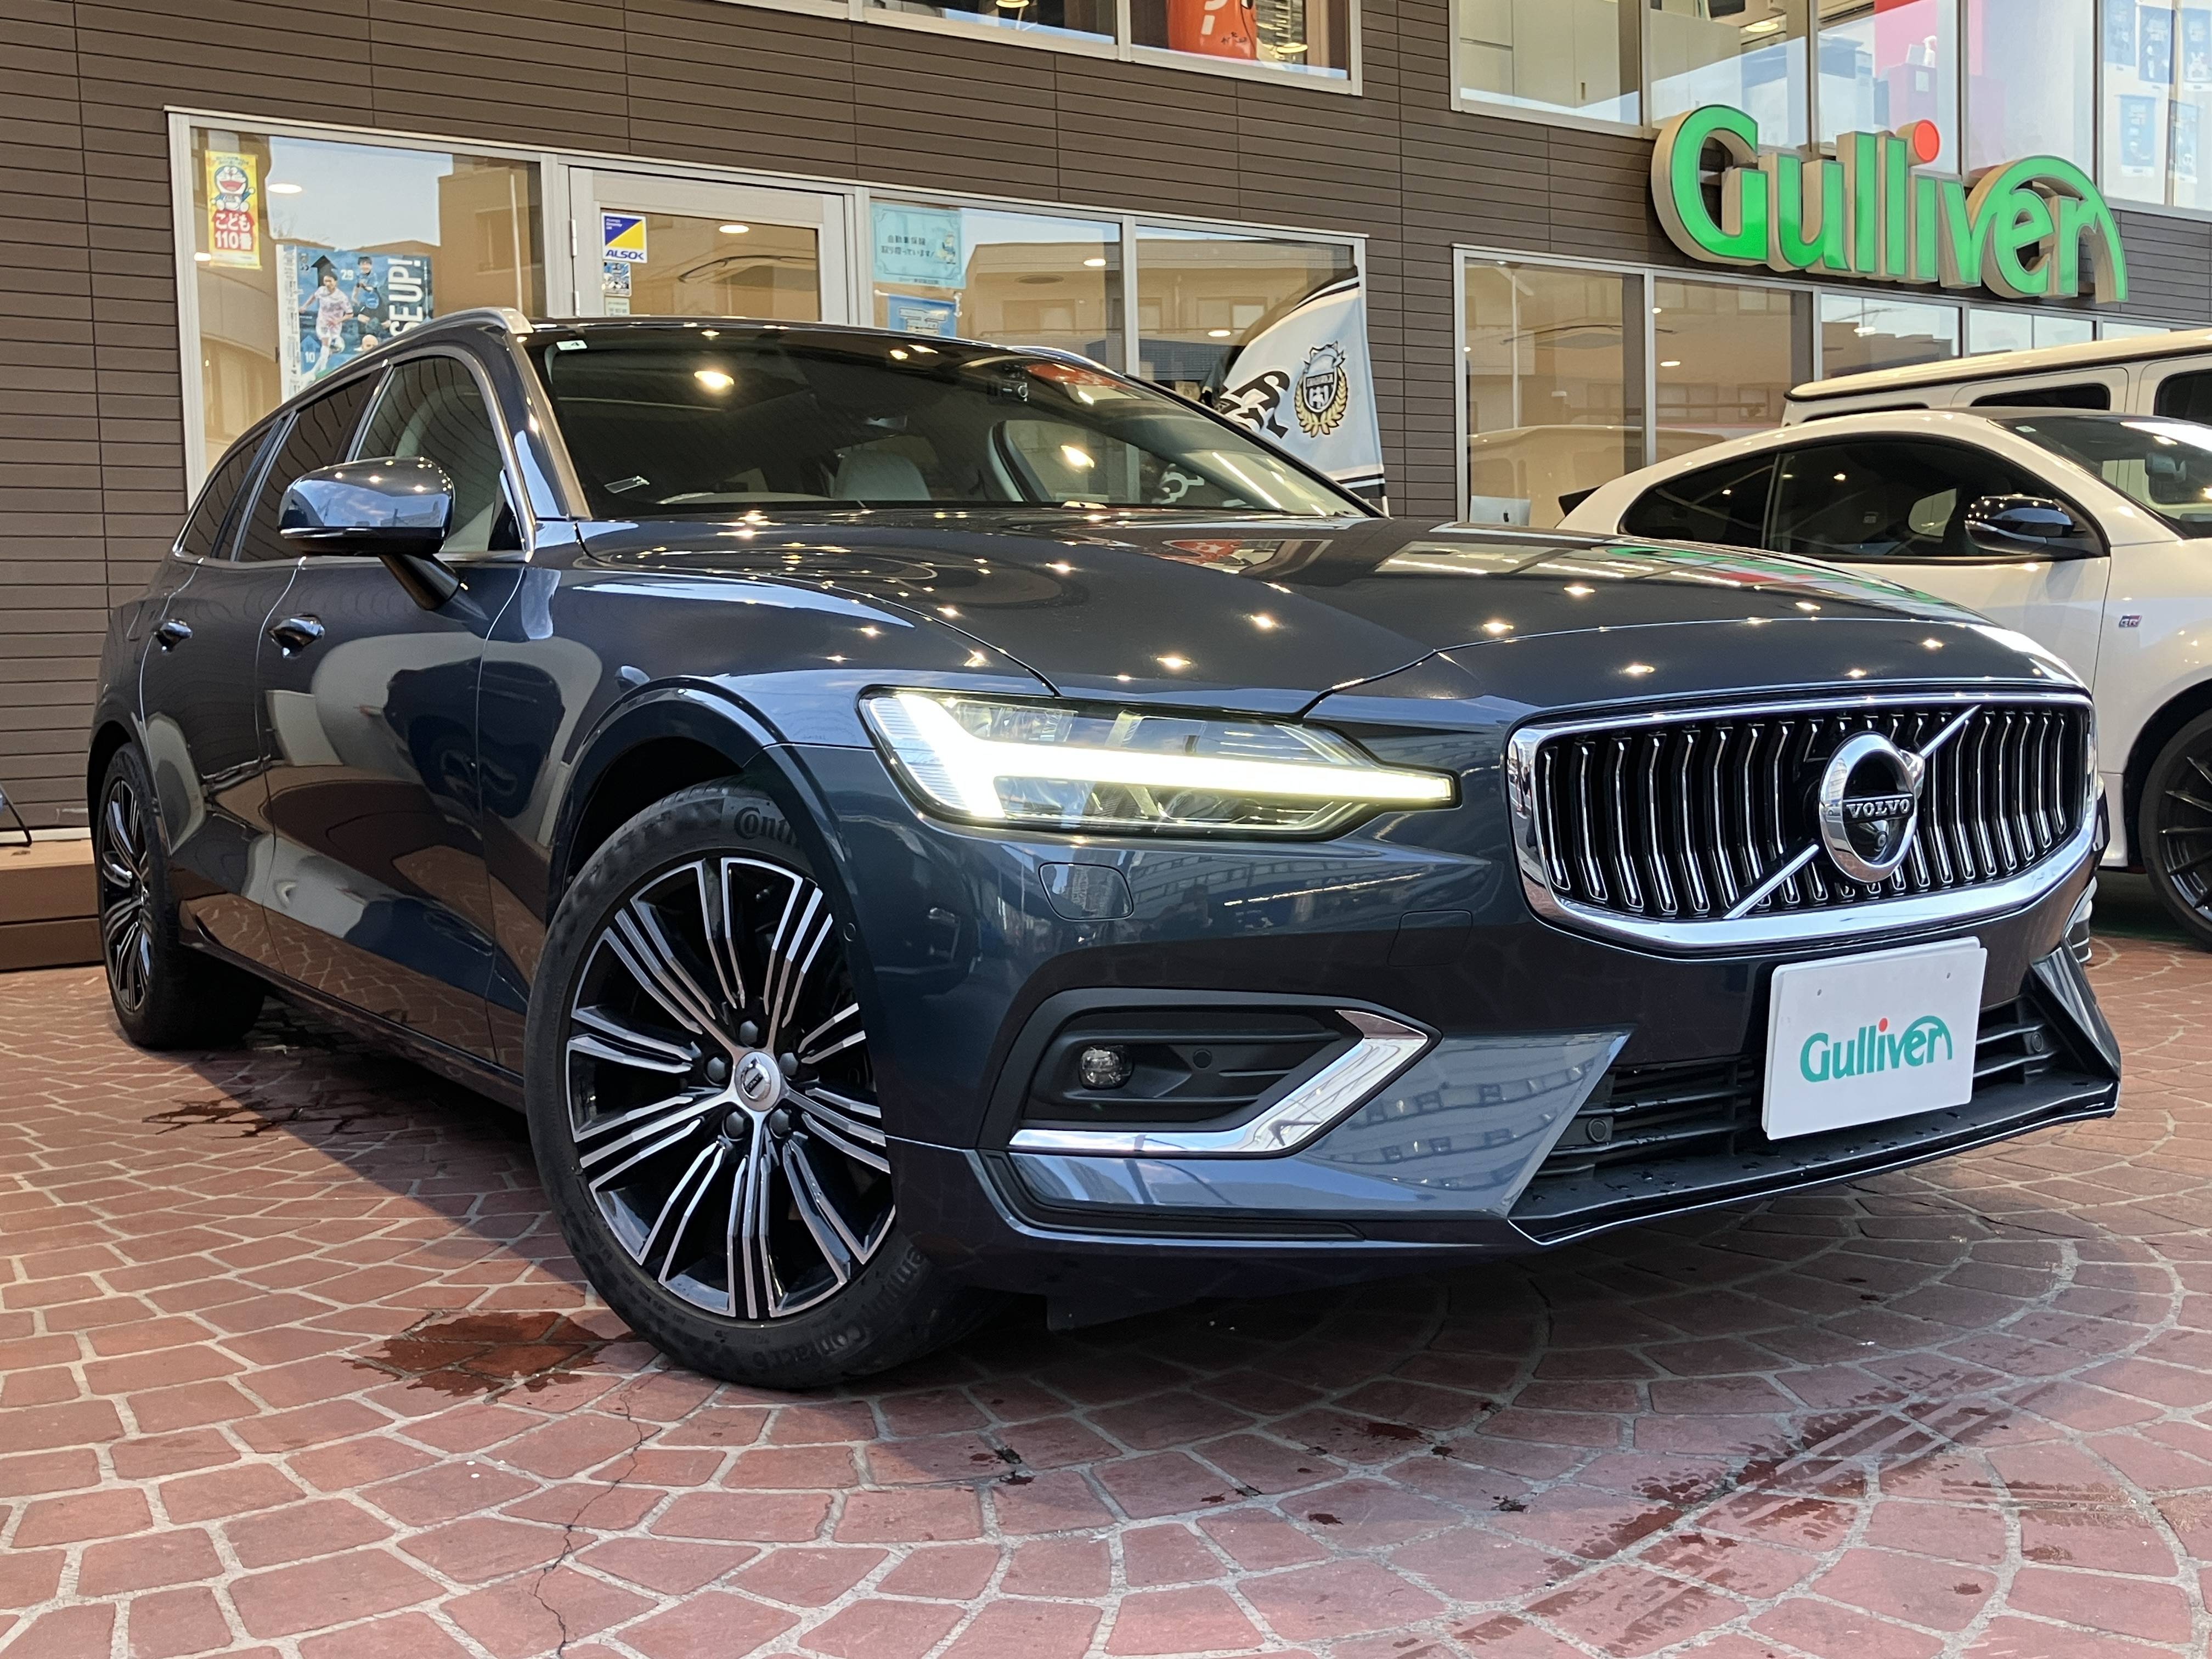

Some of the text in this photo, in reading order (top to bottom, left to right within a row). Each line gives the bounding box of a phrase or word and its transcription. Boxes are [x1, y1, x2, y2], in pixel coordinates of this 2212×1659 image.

[1654, 104, 2128, 303] Gulliver
[216, 212, 251, 232] こども
[606, 250, 644, 261] ALSOK
[305, 351, 315, 363] 10
[1846, 799, 1910, 819] VOLVO
[1800, 1015, 1953, 1082] Gulliver
